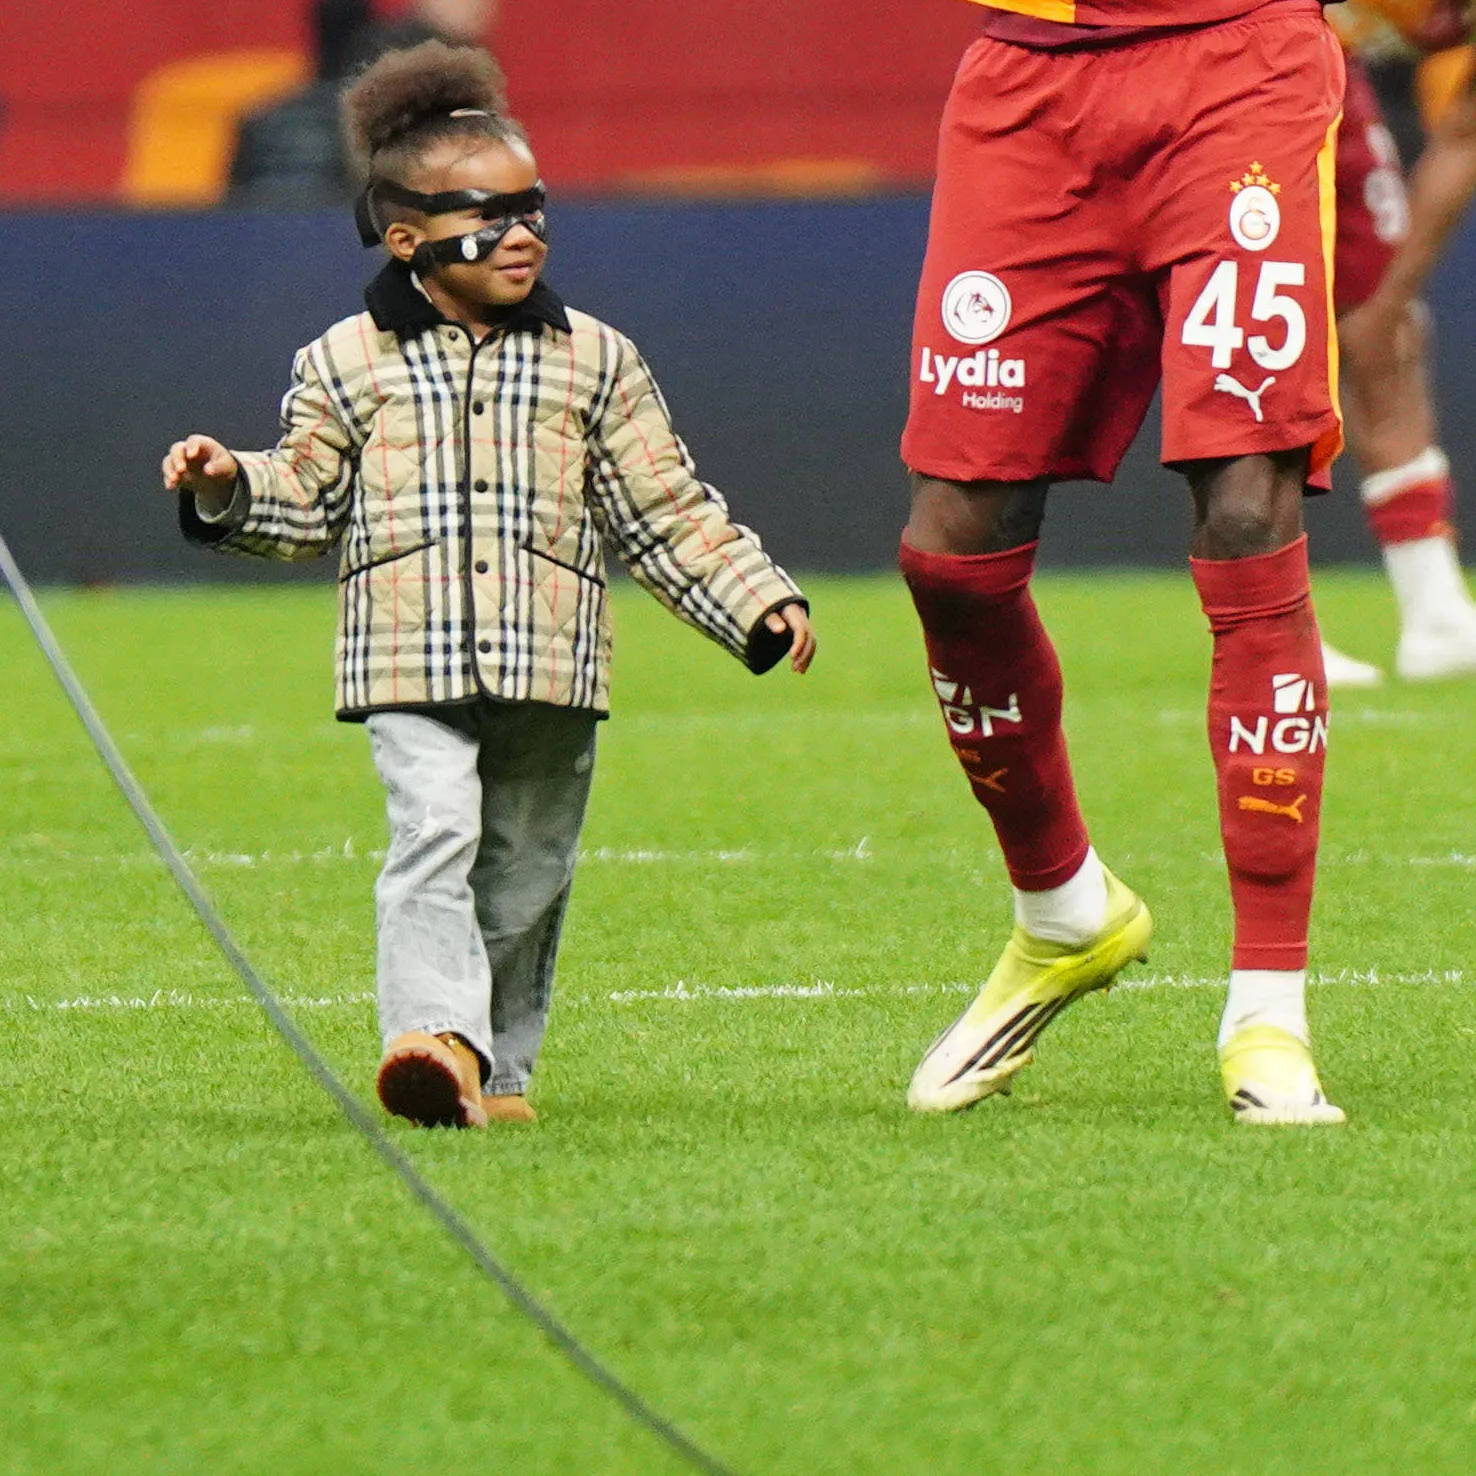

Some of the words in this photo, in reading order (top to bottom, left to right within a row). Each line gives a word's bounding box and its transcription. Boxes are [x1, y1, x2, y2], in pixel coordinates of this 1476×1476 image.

[1181, 260, 1307, 371] 45
[920, 347, 1026, 395] Lydia
[962, 391, 1024, 414] Holding
[1228, 711, 1332, 756] NGN
[1253, 767, 1297, 787] GS
